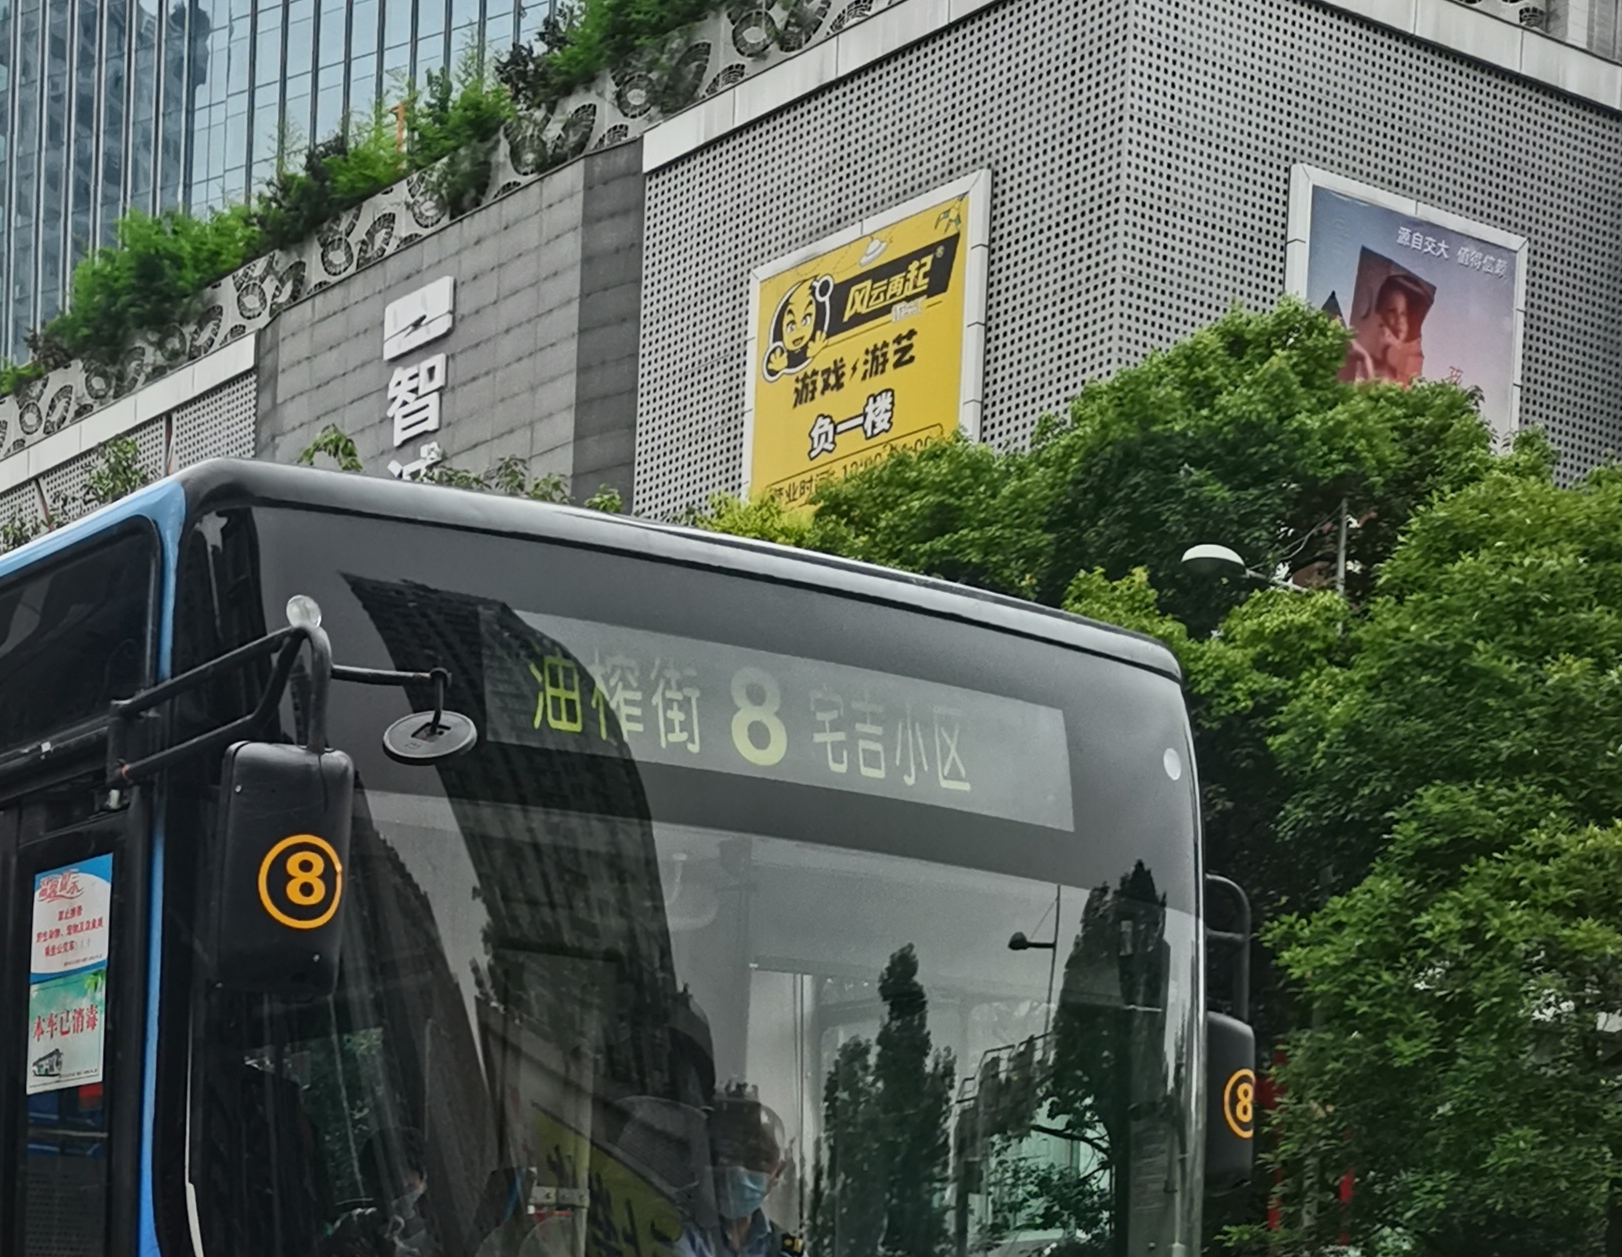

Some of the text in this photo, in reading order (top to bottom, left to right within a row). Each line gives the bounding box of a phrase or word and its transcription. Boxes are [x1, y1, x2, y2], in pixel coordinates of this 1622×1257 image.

[1396, 226, 1450, 260] 源自交大
[843, 254, 935, 323] 风云再起
[793, 329, 918, 409] 游戏 游艺
[808, 389, 895, 460] 负一楼
[530, 655, 701, 754] 油榨街
[731, 666, 788, 767] 8
[286, 851, 326, 905] 8
[33, 1003, 99, 1042] 本车已消毒
[1236, 1083, 1253, 1123] 8
